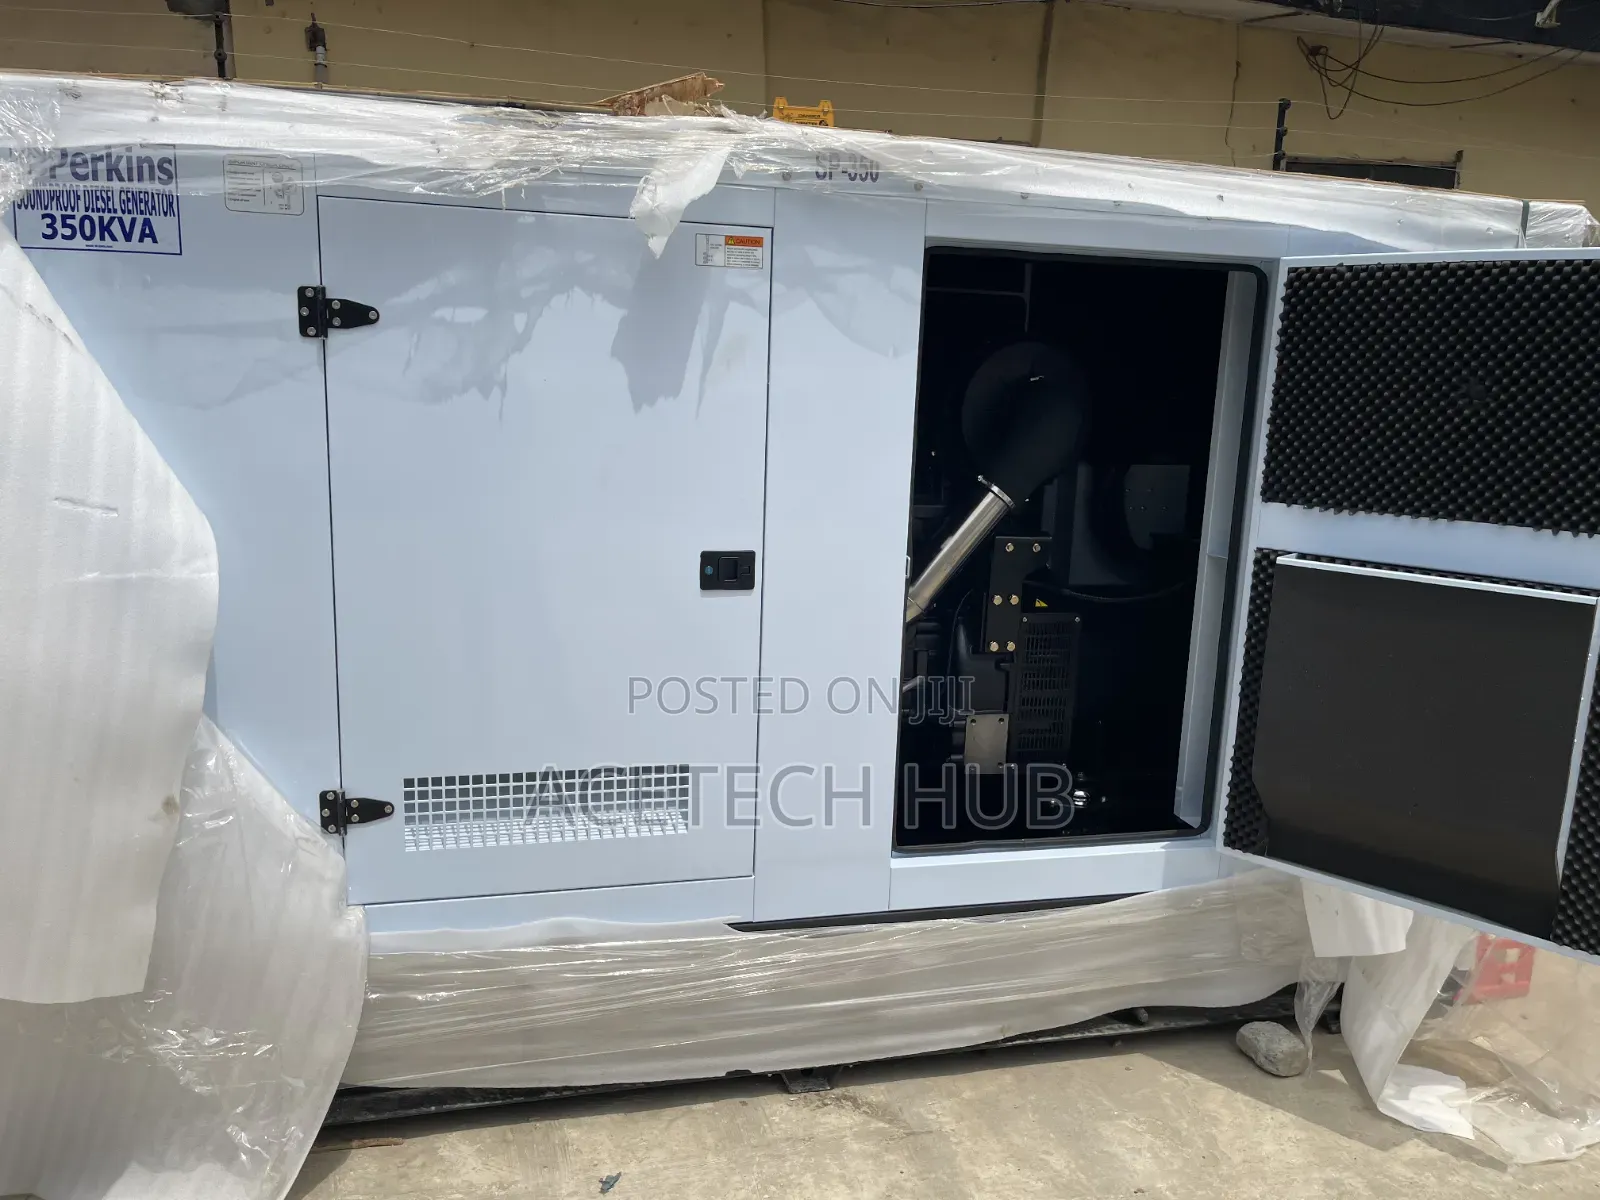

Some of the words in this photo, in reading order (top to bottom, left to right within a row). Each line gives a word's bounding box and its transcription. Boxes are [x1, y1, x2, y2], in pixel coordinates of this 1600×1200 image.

[49, 145, 174, 186] Perkins
[83, 184, 118, 215] DIESEL
[119, 186, 176, 218] GENERATOR
[41, 213, 159, 244] 350KVA
